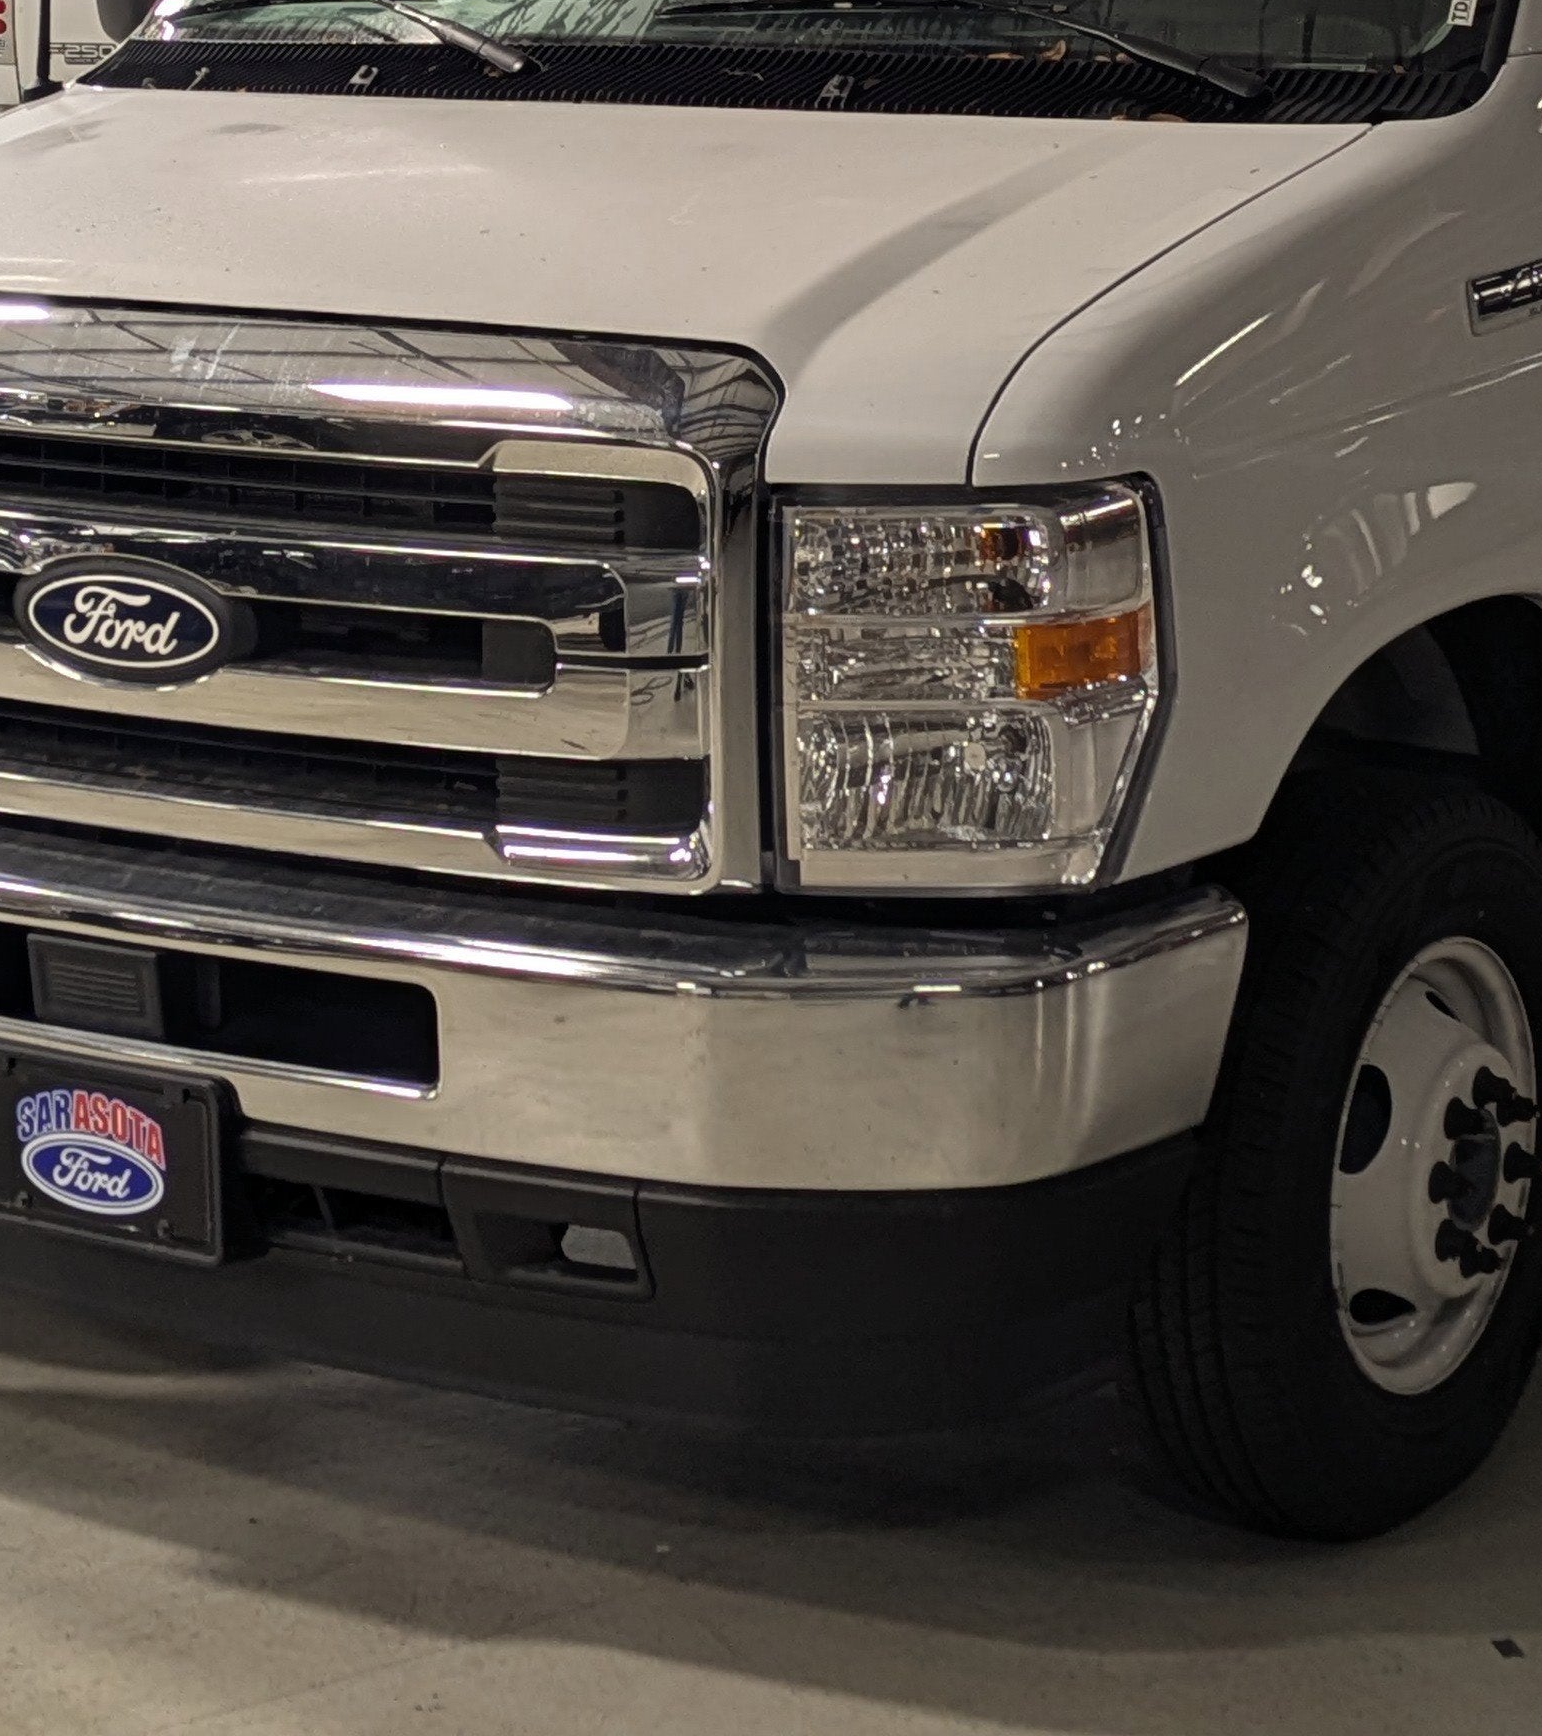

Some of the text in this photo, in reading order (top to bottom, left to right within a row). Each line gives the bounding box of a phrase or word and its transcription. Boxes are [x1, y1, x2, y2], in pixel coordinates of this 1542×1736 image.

[62, 584, 181, 656] Ford
[15, 1089, 167, 1172] SARASOTA
[51, 1146, 132, 1200] Ford
